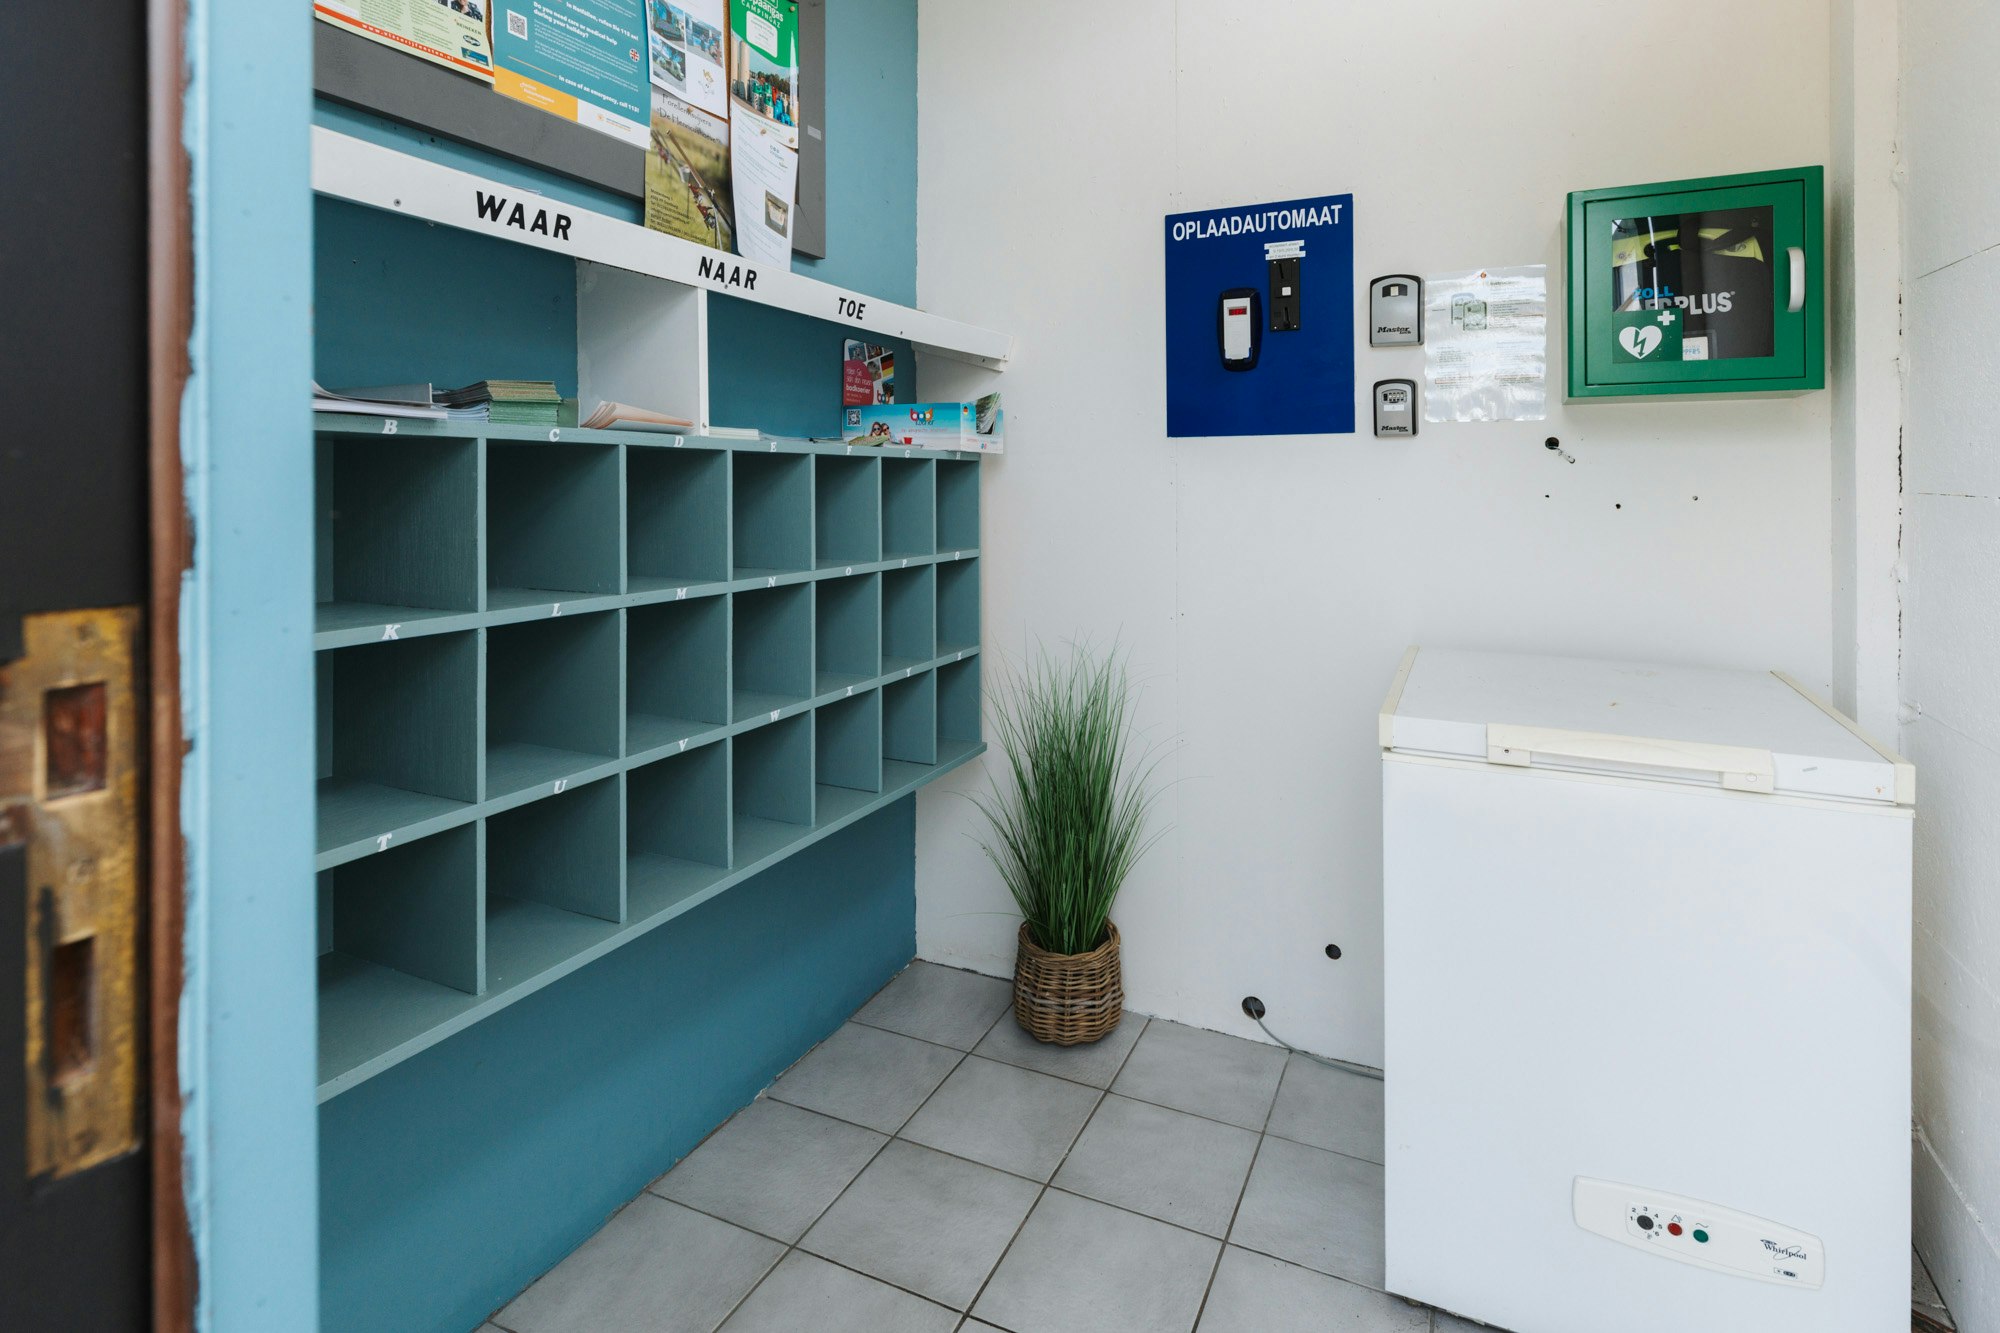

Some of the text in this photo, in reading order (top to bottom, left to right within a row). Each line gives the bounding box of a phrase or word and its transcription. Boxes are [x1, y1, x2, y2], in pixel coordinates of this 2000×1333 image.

[533, 1, 542, 9] Do
[542, 6, 553, 15] you
[553, 10, 568, 22] need
[1172, 204, 1343, 242] OPLAADAUTOMAAT
[476, 190, 867, 321] WAAR NAAR TOE
[1632, 286, 1674, 300] ZOLL
[1674, 292, 1732, 315] PLUS
[1376, 326, 1410, 334] Master
[382, 419, 397, 434] B
[549, 429, 559, 442] C
[673, 436, 684, 447] D
[770, 442, 777, 452] E
[846, 445, 852, 455] F
[905, 450, 910, 458] G
[902, 559, 907, 568] P
[846, 567, 851, 576] O
[768, 577, 776, 587] N
[676, 588, 687, 599] M
[551, 603, 561, 616] L
[382, 624, 401, 639] K
[846, 686, 853, 696] X
[770, 709, 781, 722] W
[678, 738, 688, 751] V
[554, 780, 567, 794] U
[377, 833, 392, 851] T
[1764, 1243, 1806, 1260] Whirlpool
